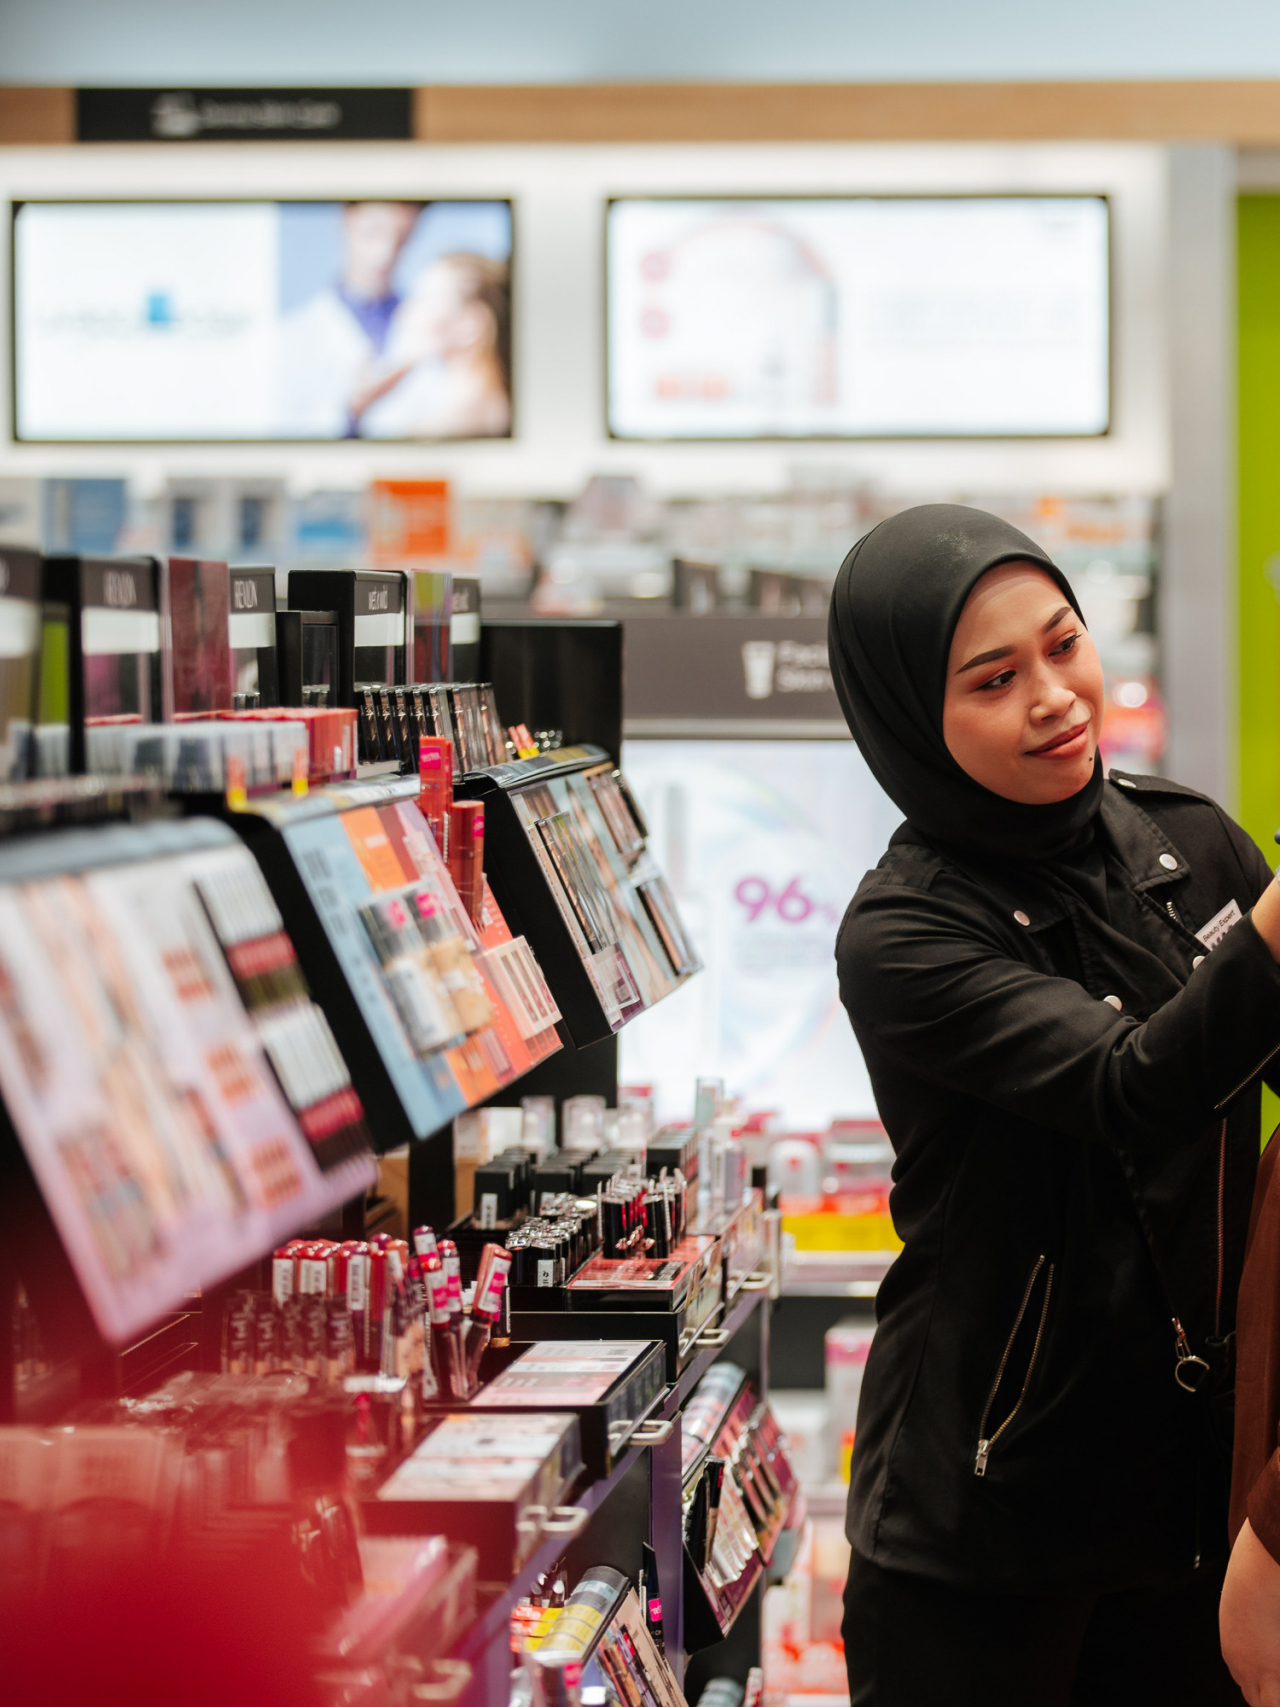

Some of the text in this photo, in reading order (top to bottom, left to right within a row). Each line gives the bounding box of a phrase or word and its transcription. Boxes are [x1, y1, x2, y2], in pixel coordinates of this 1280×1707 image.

[234, 579, 258, 609] REVLON
[1202, 926, 1219, 942] Beauty
[1219, 910, 1235, 927] Expert
